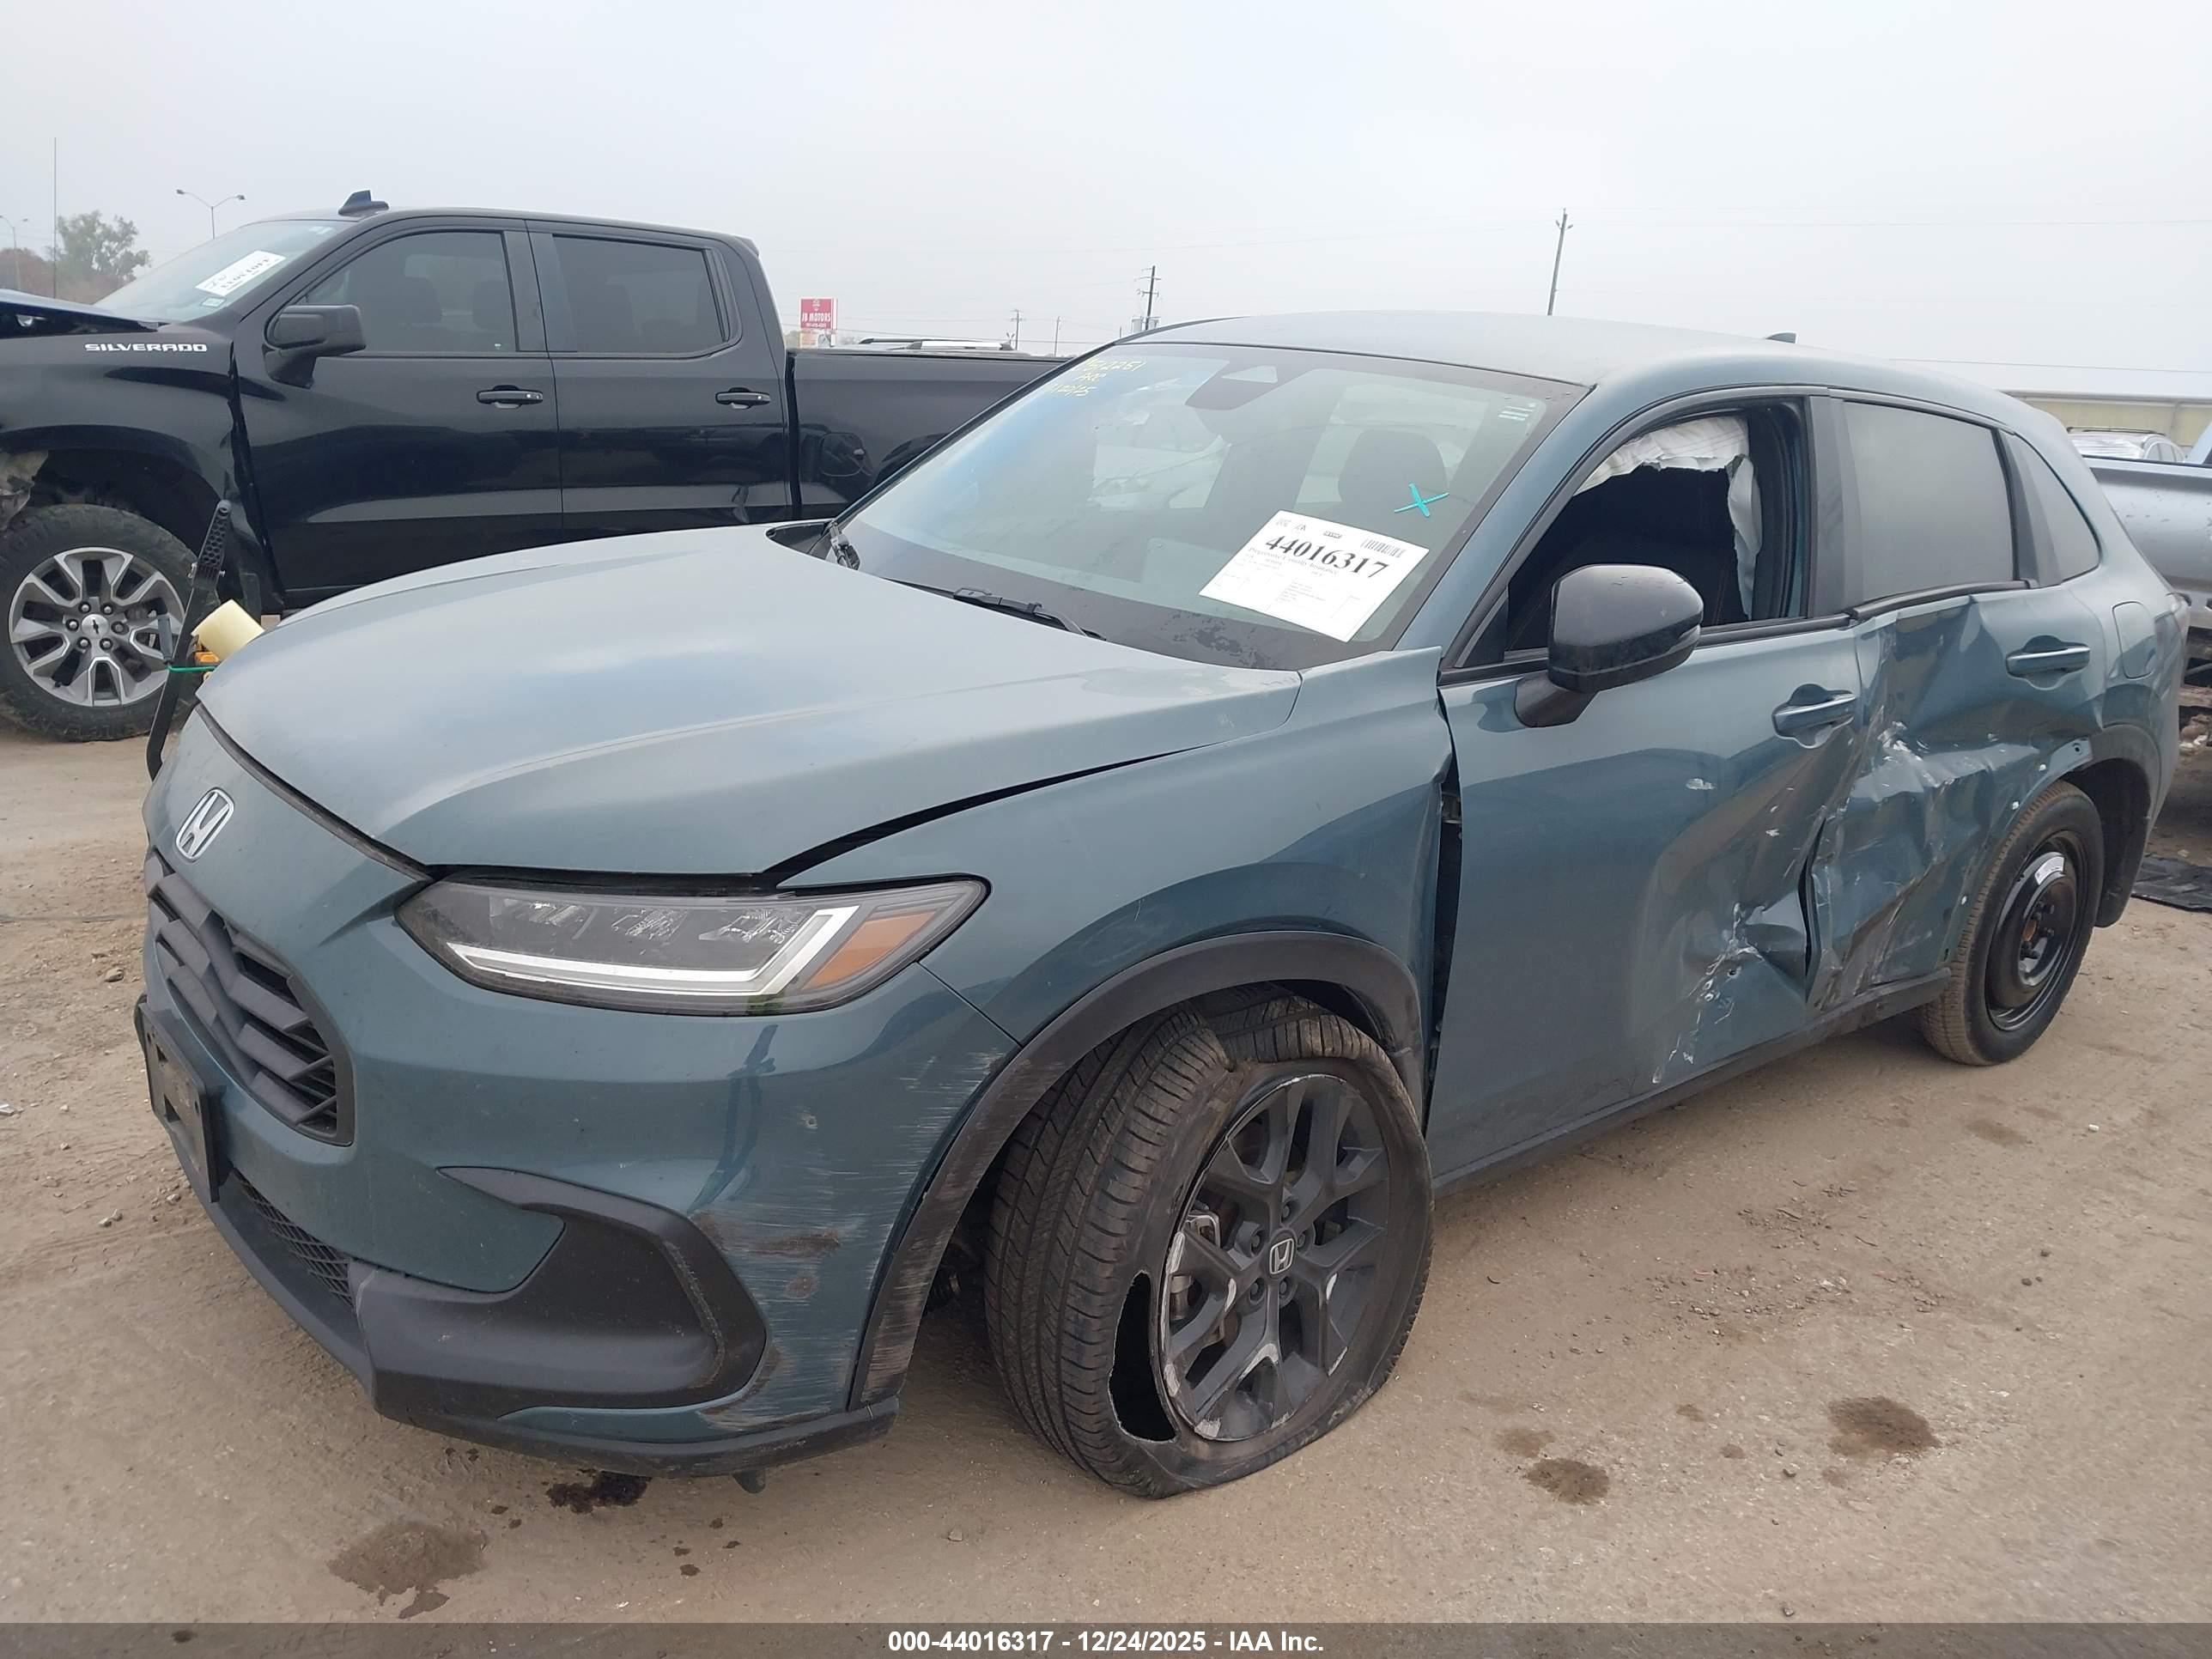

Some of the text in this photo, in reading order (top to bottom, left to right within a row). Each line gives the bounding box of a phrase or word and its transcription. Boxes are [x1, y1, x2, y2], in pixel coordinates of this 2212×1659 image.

[809, 312, 831, 323] MOTORS
[84, 343, 208, 352] SILVERADO
[1265, 535, 1390, 579] 44016317
